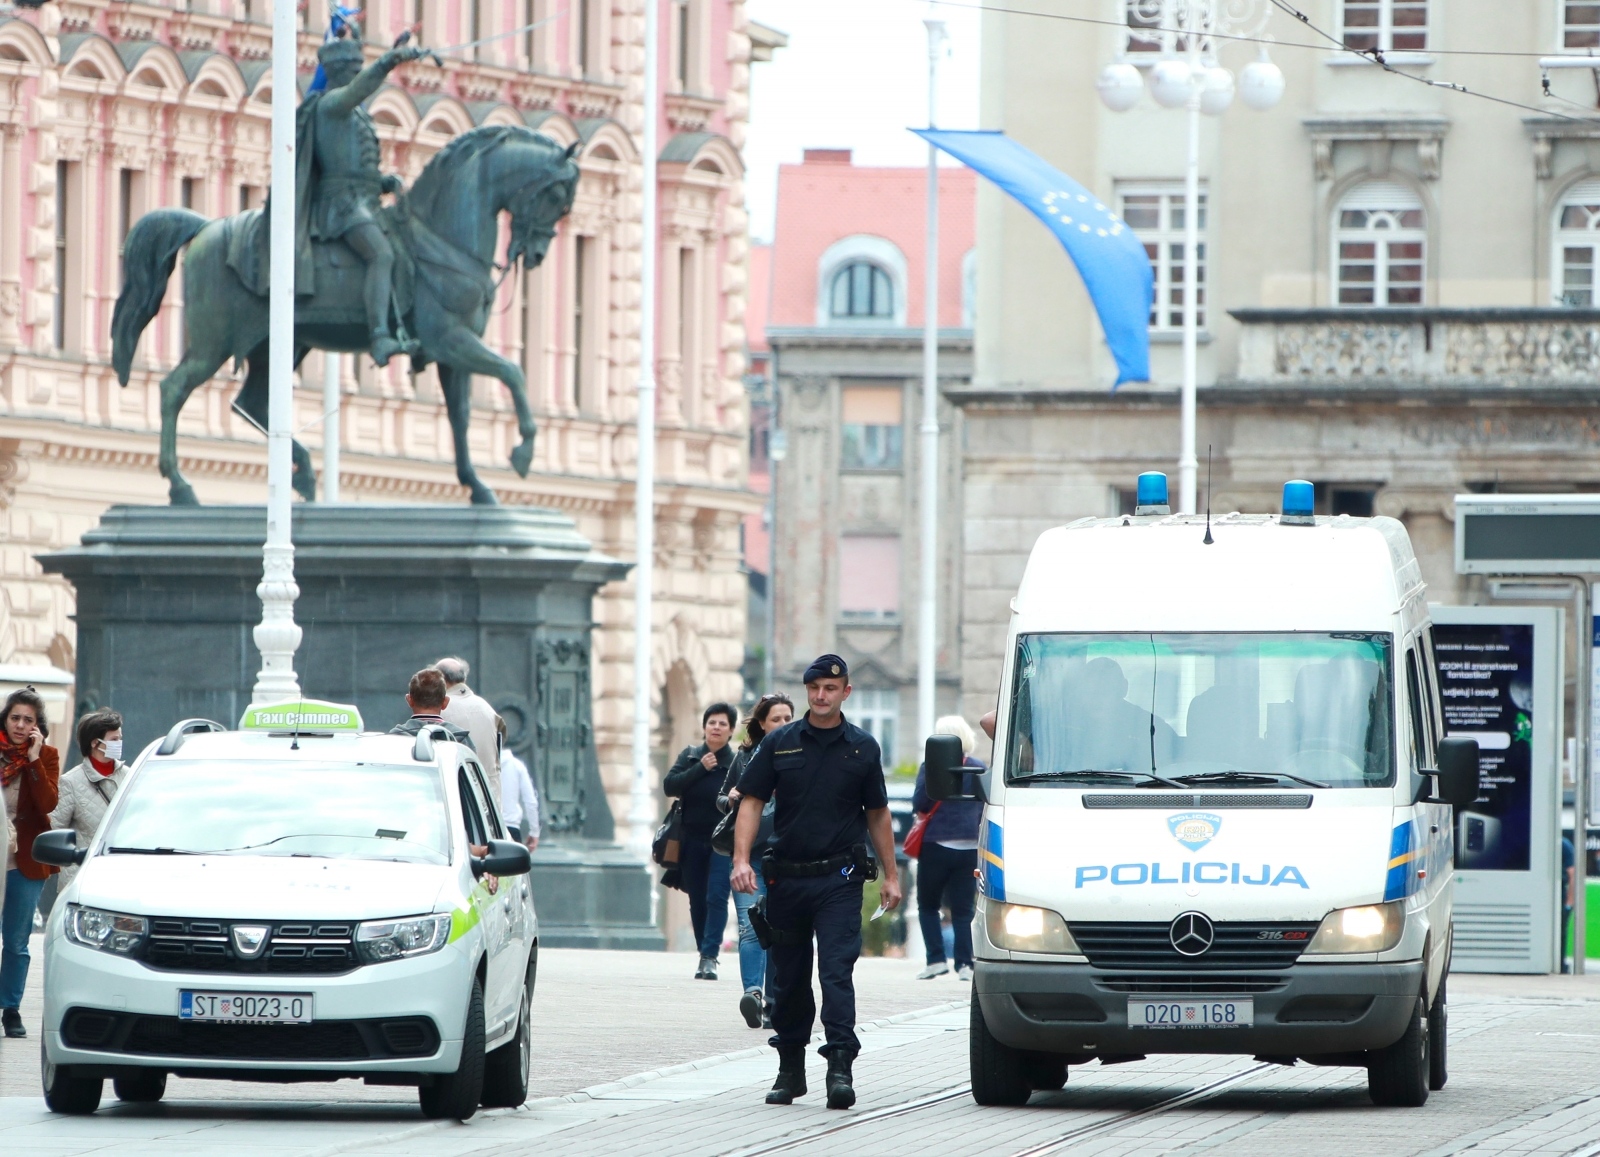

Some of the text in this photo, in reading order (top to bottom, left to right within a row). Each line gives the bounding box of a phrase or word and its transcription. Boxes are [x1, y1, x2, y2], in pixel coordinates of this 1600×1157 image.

[1439, 662, 1463, 670] ZOOM
[285, 712, 349, 726] Cammeo
[1169, 814, 1220, 824] POLICIJA
[1075, 862, 1310, 889] POLICIJA
[194, 995, 303, 1018] ST 9023-0
[1145, 1003, 1235, 1024] 020 168
